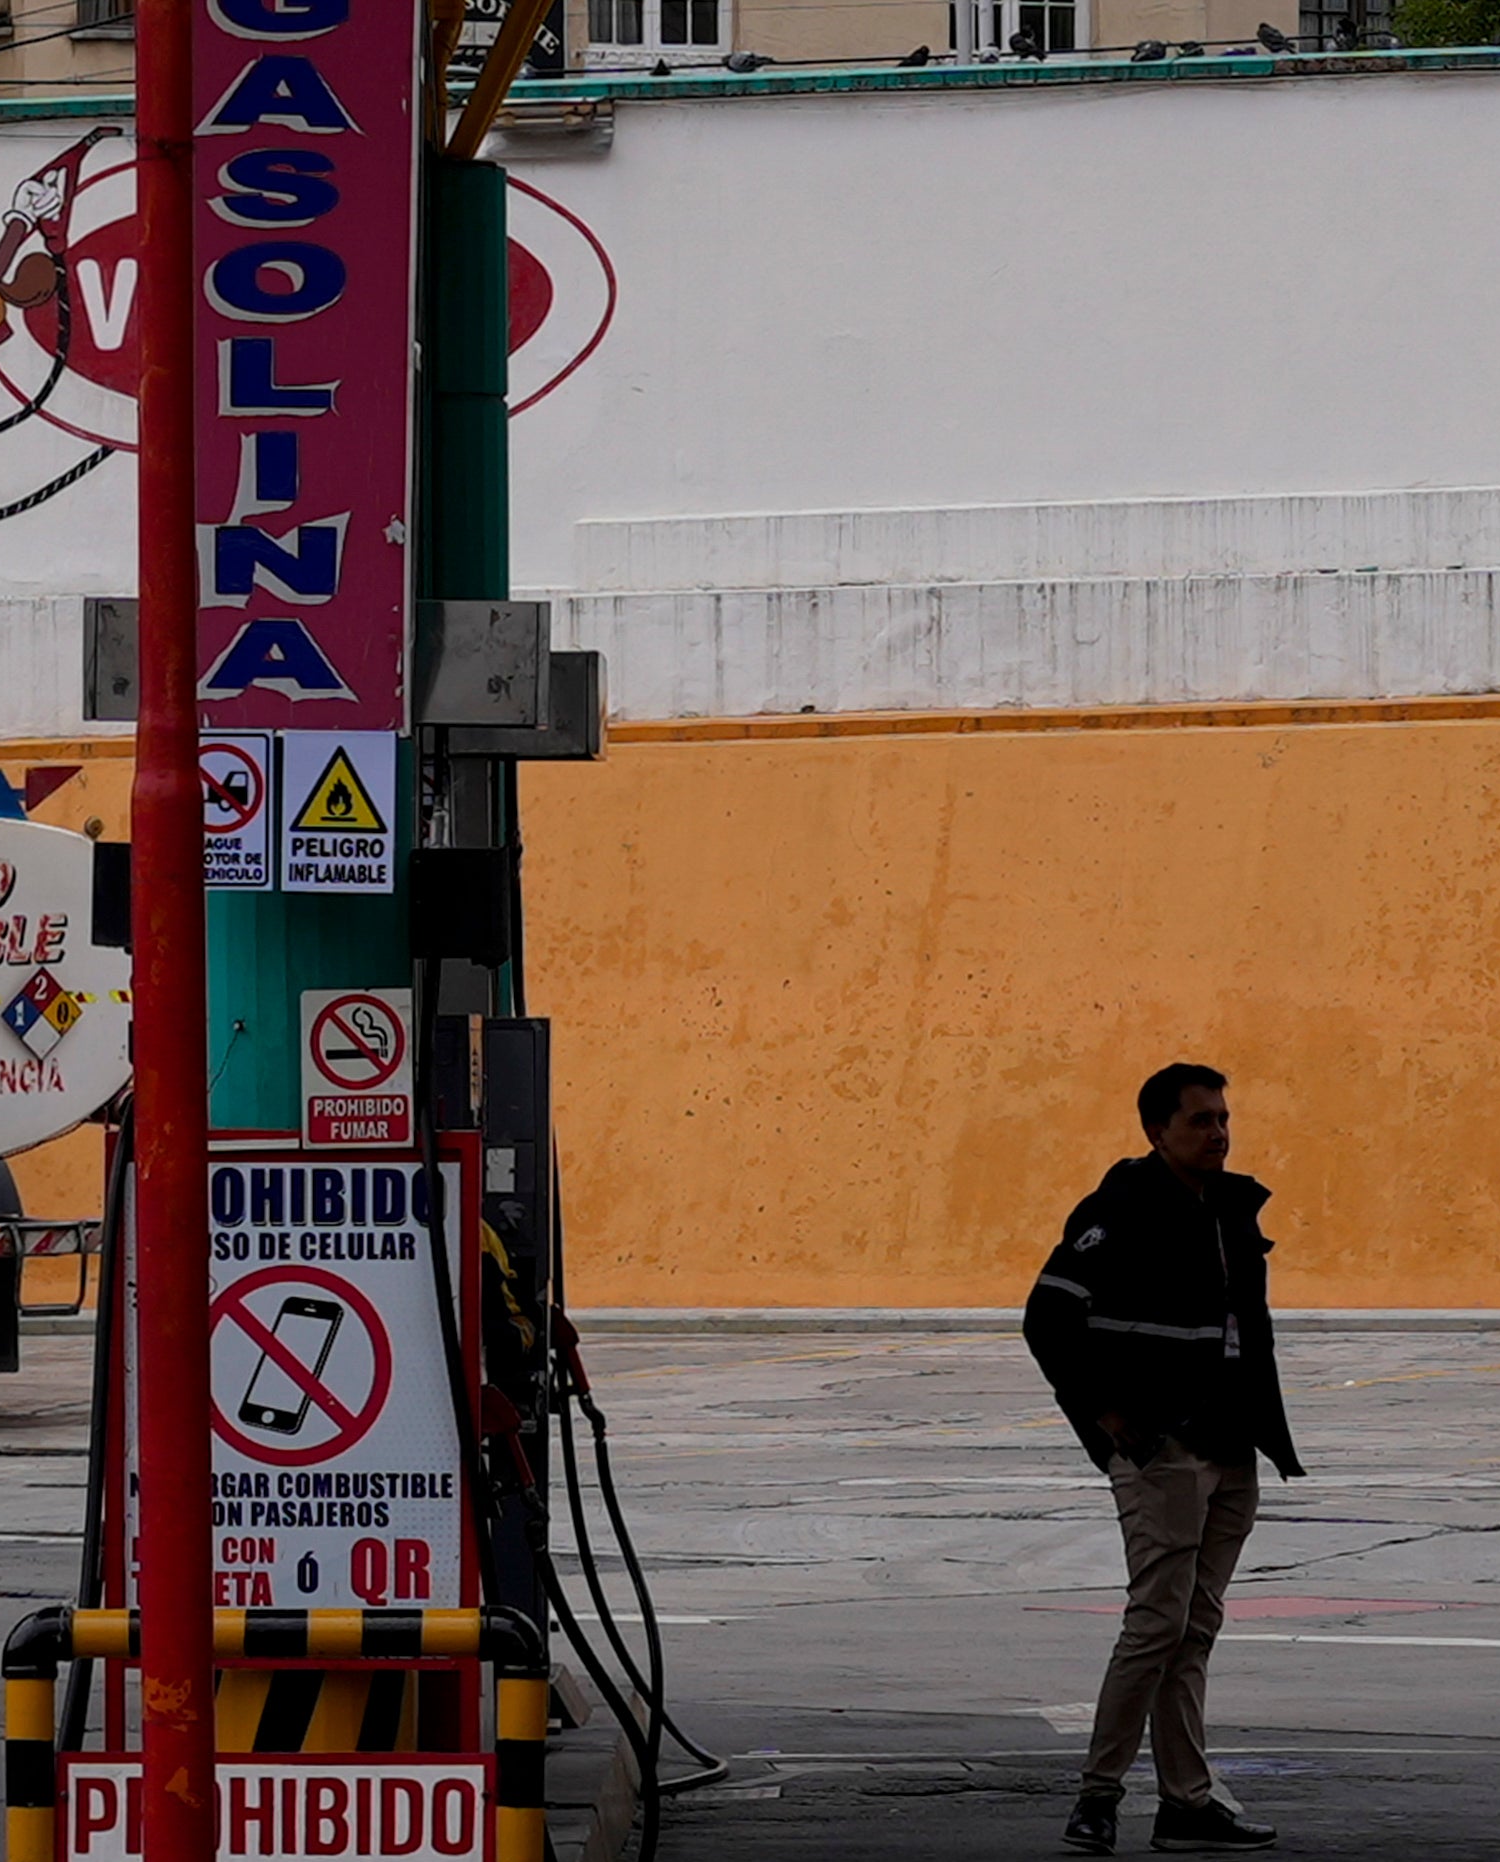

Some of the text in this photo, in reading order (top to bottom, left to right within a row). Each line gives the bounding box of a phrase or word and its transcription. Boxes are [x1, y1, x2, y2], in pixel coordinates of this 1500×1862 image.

[245, 853, 262, 865] DE
[291, 838, 385, 858] PELIGRO
[289, 863, 387, 883] INFLAMABLE
[34, 975, 48, 1000] 2
[14, 1000, 69, 1027] 1 0
[313, 1097, 405, 1118] PROHIBIDO
[330, 1120, 389, 1140] FUMAR
[259, 1233, 291, 1260] DE
[299, 1232, 417, 1261] CELULAR
[277, 1472, 453, 1499] COMBUSTIBLE
[251, 1501, 390, 1527] PASAJEROS
[222, 1537, 275, 1564] CON
[350, 1537, 431, 1606] QR
